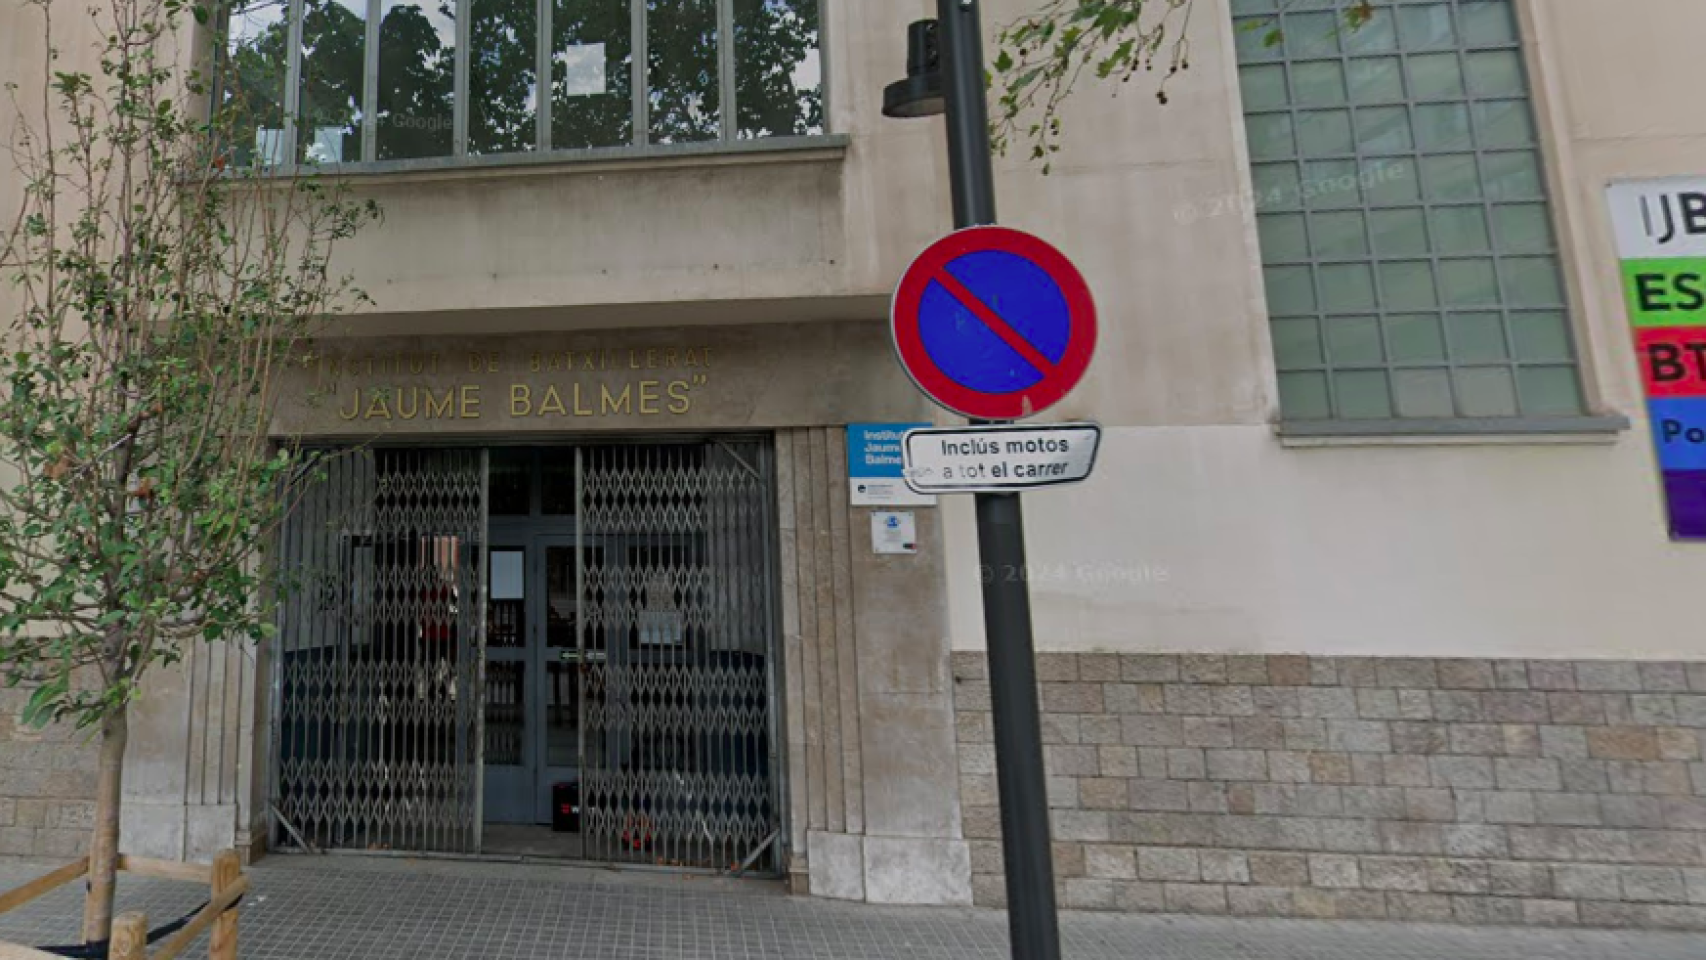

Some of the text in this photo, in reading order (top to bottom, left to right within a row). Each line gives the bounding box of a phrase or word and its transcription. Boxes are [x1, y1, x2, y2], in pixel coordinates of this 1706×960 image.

[467, 350, 500, 374] DE
[530, 347, 710, 373] BATXILLERAT
[941, 437, 1070, 455] Inclús motos
[943, 461, 1069, 479] a tot el carrer
